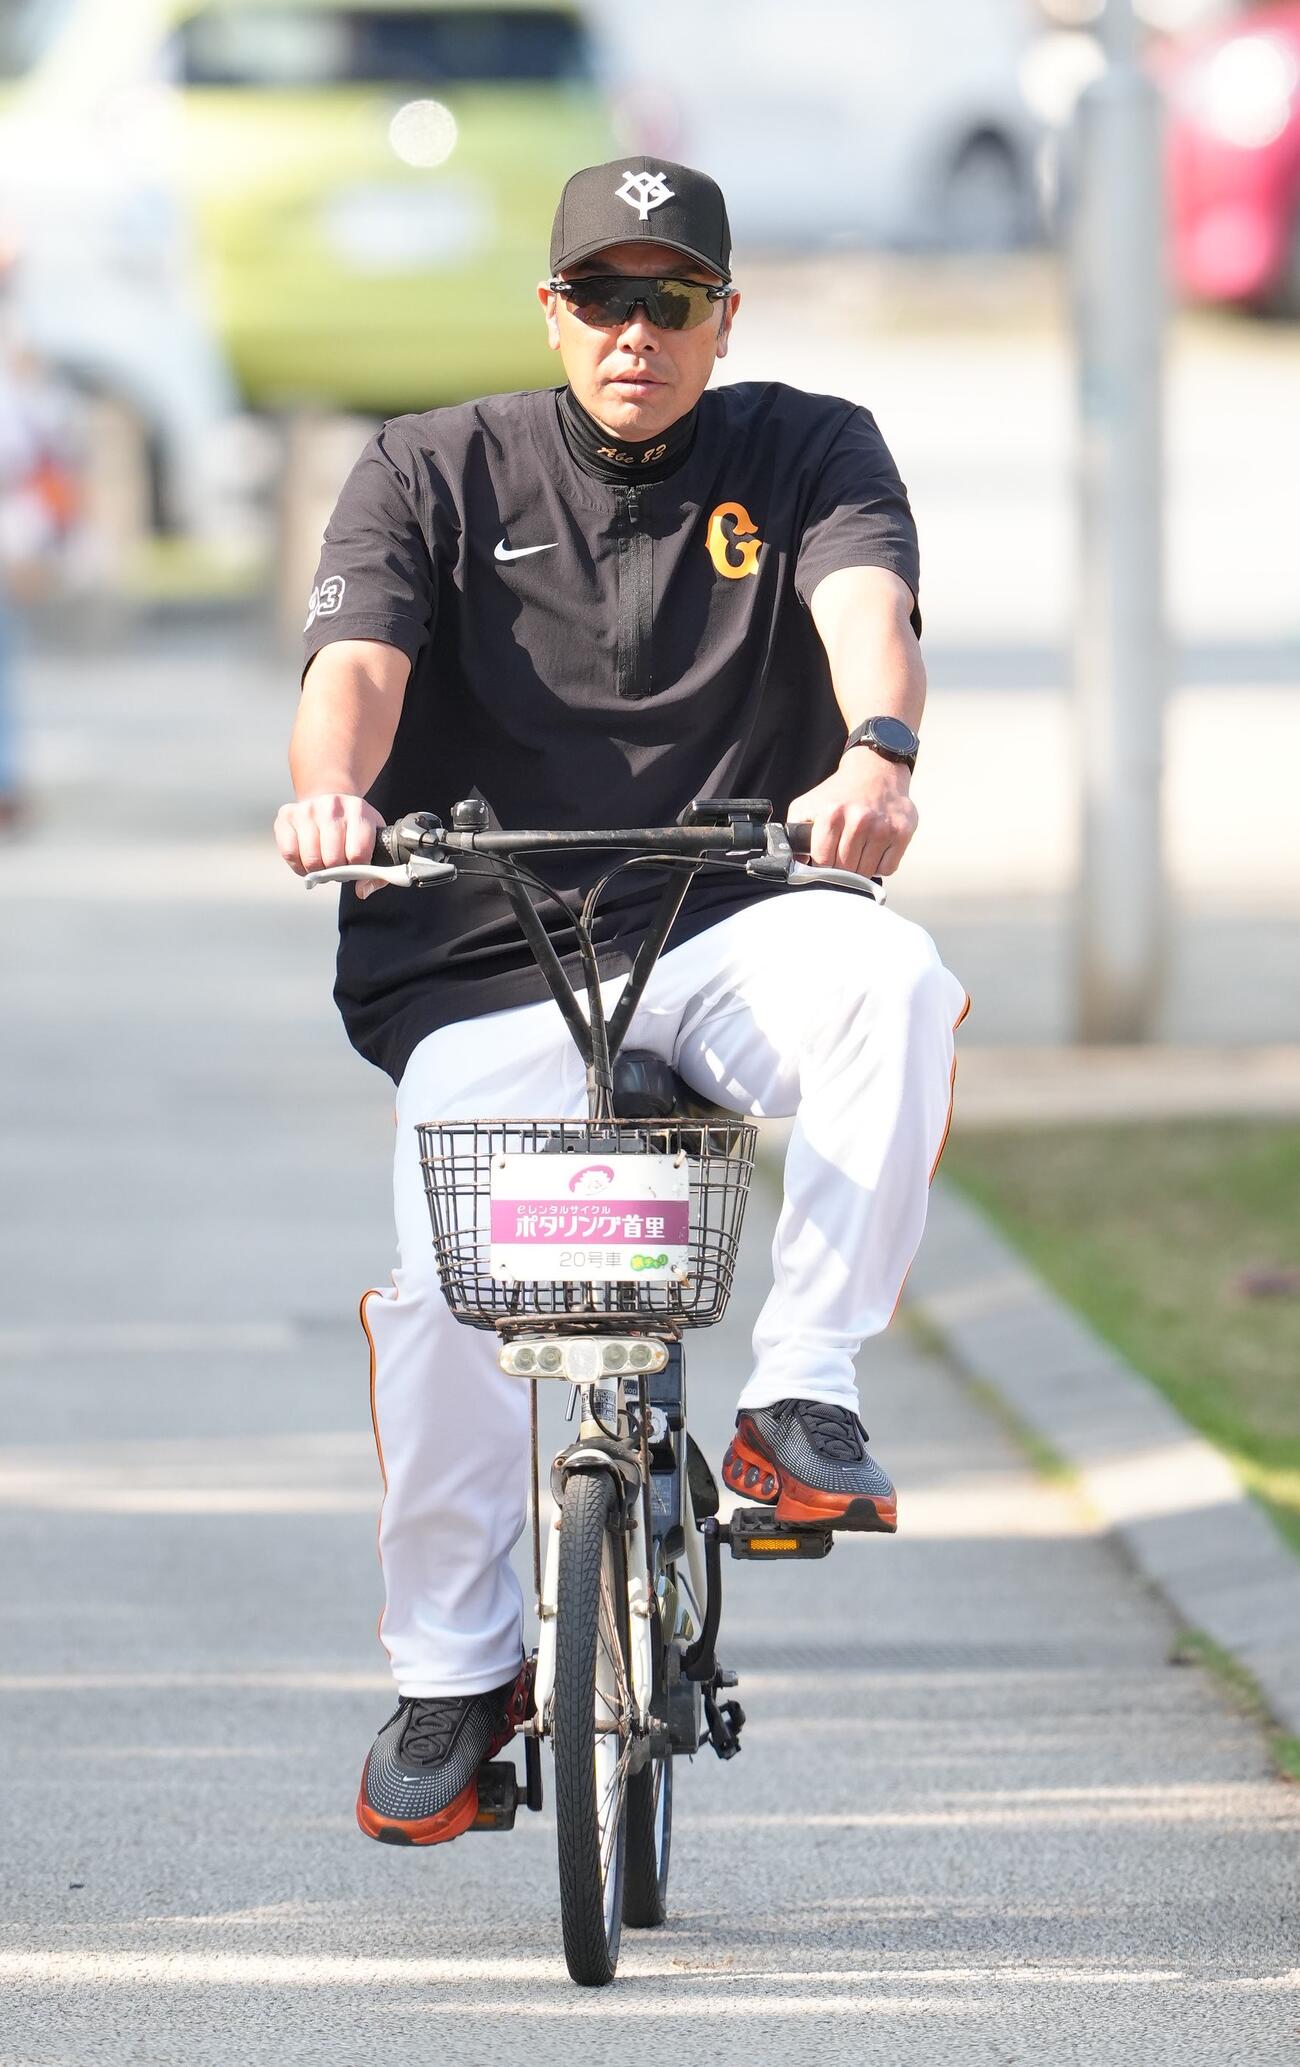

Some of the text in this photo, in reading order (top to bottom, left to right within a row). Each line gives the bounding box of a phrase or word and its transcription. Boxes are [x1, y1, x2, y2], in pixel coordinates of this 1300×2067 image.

[640, 443, 667, 464] 83
[704, 501, 763, 579] G
[515, 1214, 665, 1239] ポタリング首里
[559, 1250, 623, 1269] 20号車
